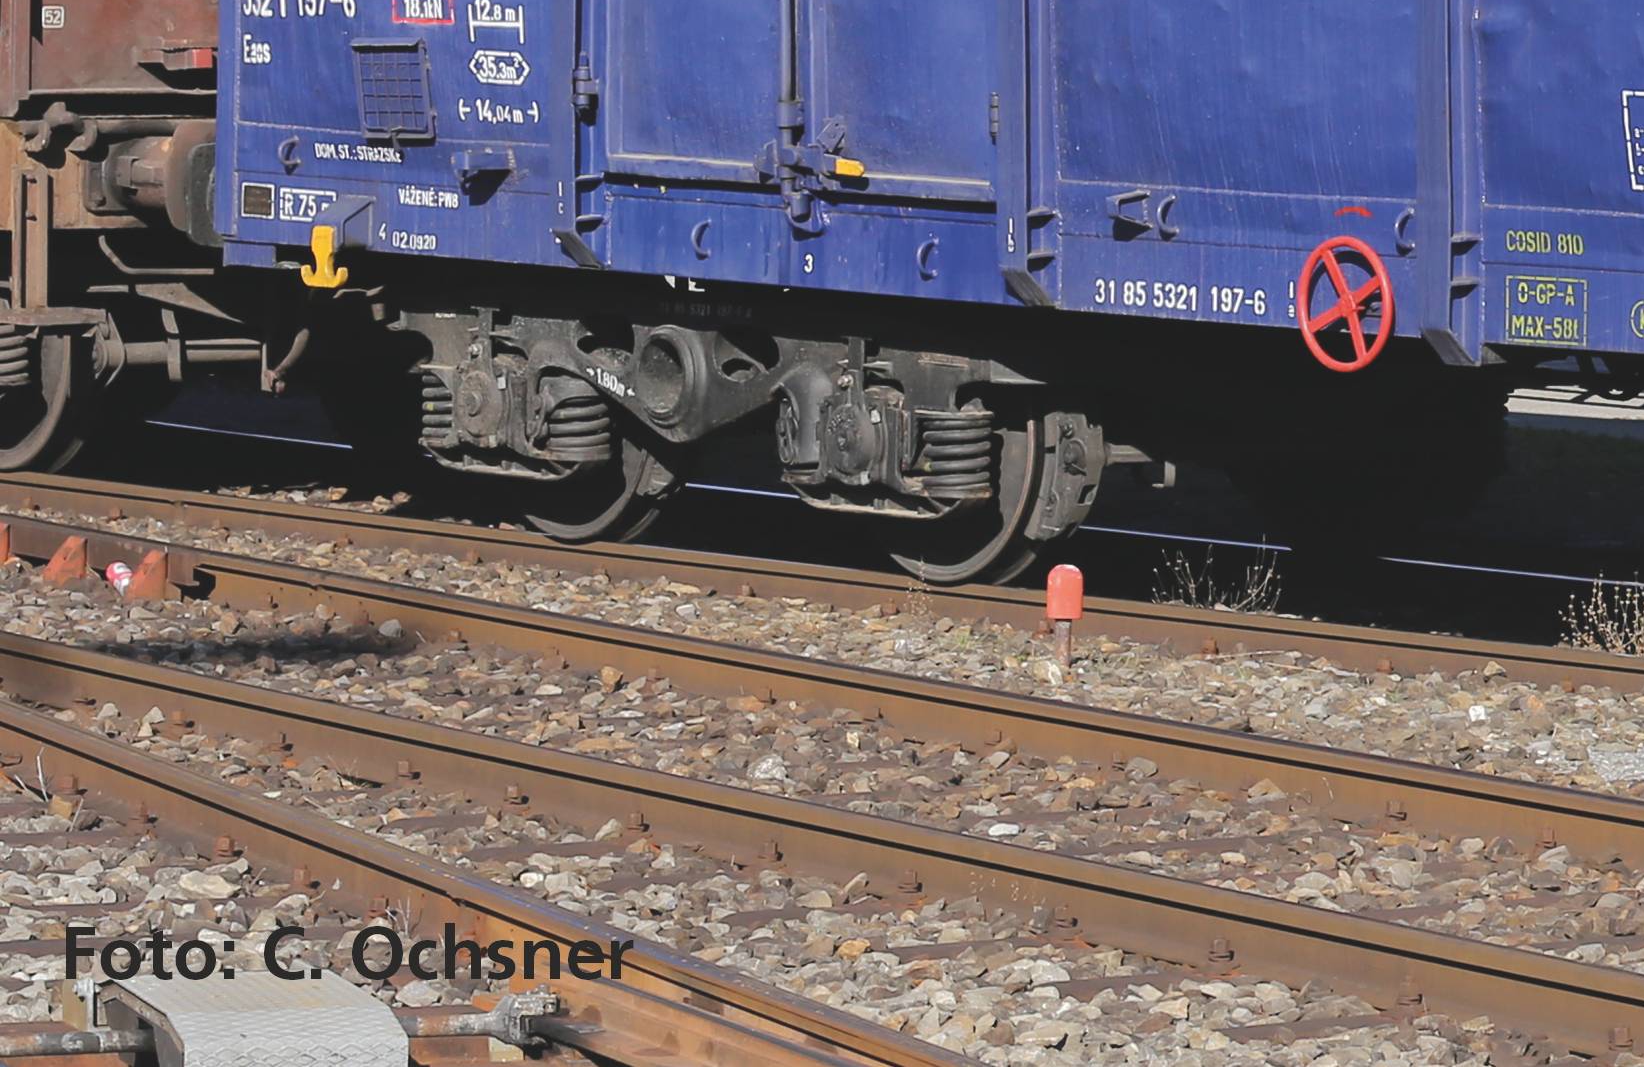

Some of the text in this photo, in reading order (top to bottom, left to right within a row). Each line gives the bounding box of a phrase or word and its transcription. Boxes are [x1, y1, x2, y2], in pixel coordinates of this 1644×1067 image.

[45, 10, 61, 24] 52
[283, 194, 294, 216] R
[299, 194, 317, 218] 75
[378, 222, 387, 241] 4
[1506, 230, 1584, 256] COSID 810
[803, 254, 814, 275] 3
[1094, 280, 1266, 316] 31 85 5321 197-6
